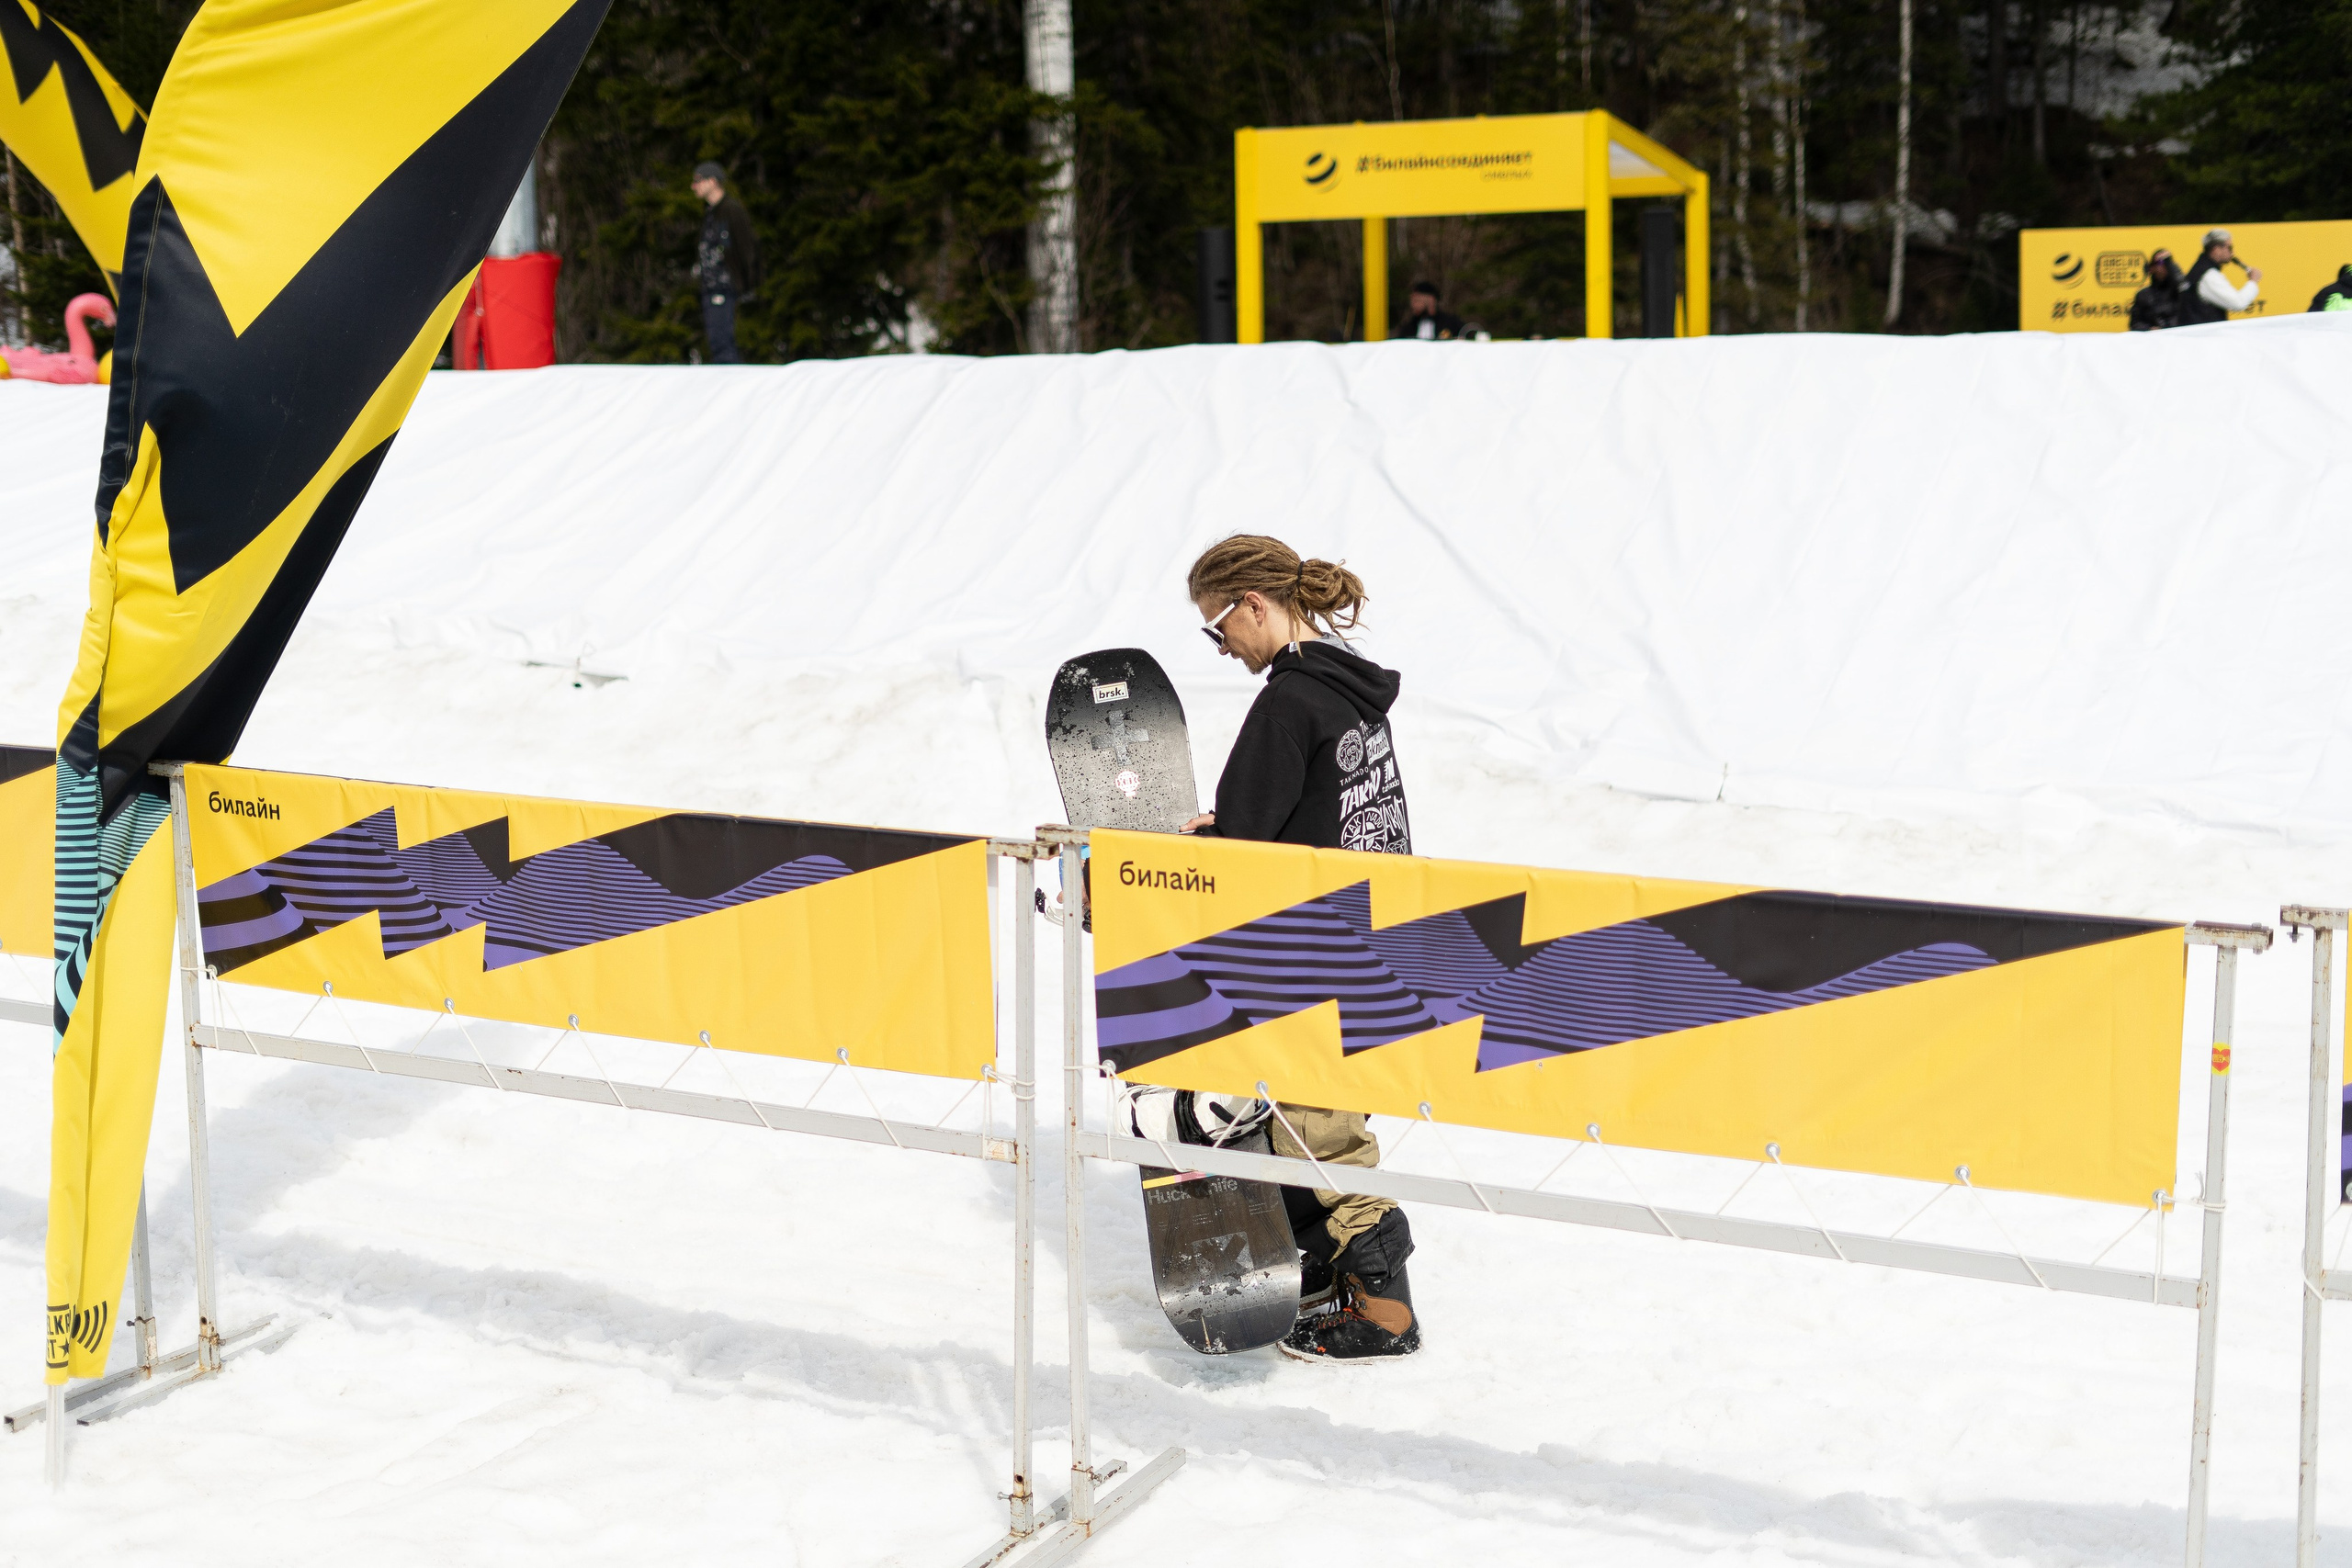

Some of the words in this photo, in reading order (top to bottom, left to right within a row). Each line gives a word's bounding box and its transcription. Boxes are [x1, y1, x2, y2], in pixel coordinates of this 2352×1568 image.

[1099, 687, 1125, 699] brsk.
[1340, 766, 1369, 786] TAKNADO
[209, 790, 280, 821] билайн
[1344, 816, 1362, 840] TAK
[1119, 860, 1216, 895] билайн
[1148, 1182, 1192, 1205] Huck
